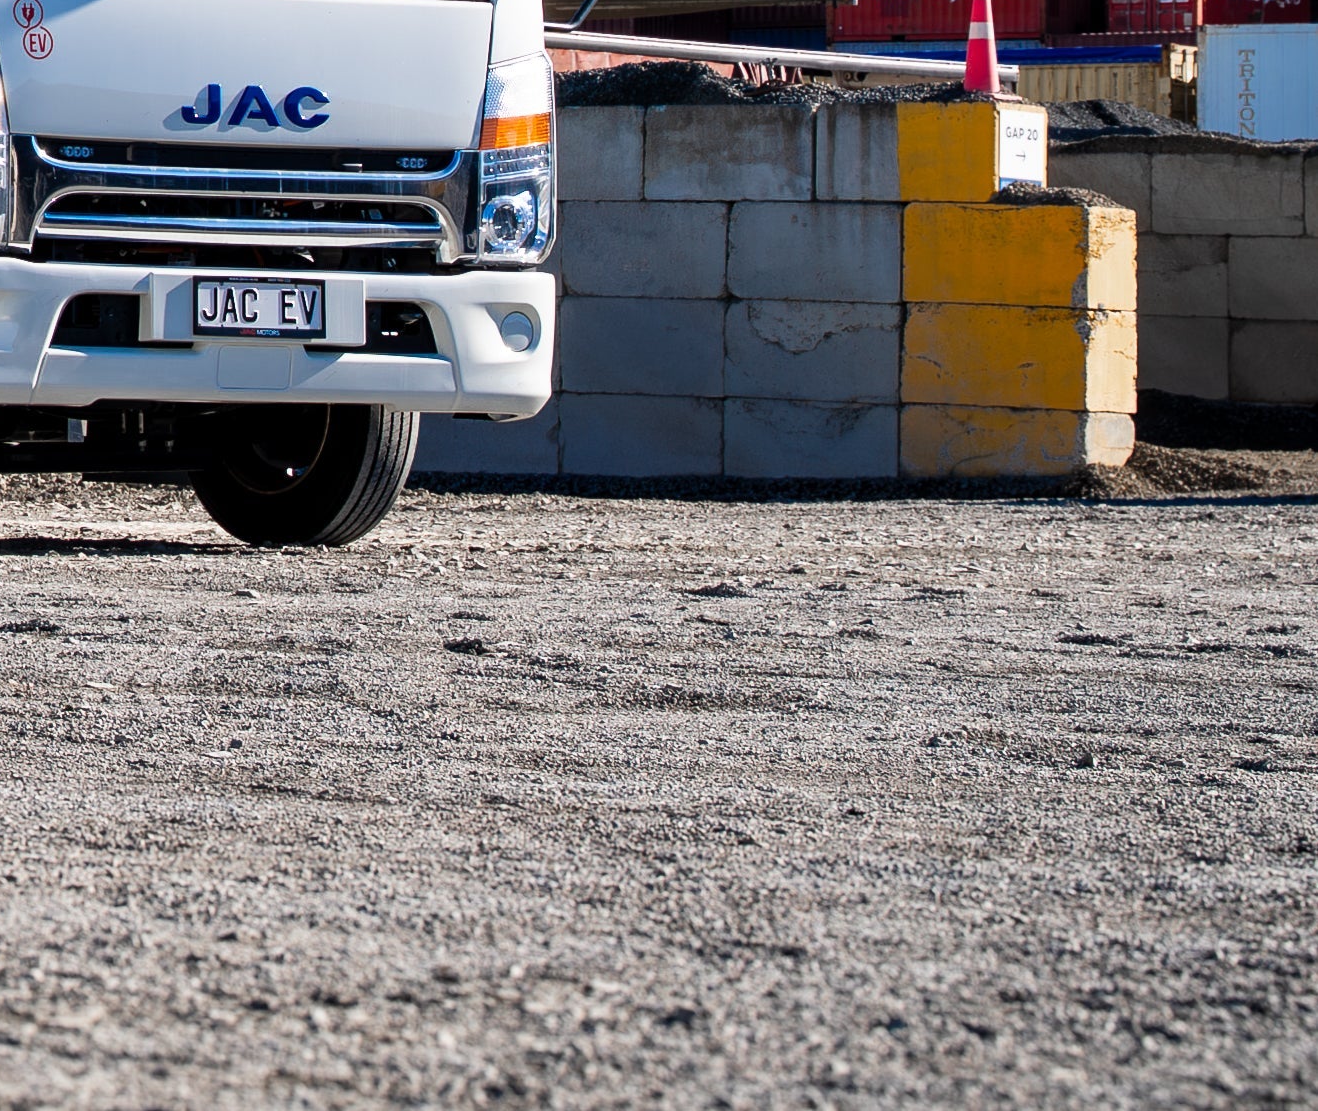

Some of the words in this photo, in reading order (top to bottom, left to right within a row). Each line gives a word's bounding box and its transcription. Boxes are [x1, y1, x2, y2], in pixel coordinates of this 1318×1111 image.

[29, 33, 47, 53] EV
[181, 83, 331, 129] JAC
[1238, 49, 1256, 137] TRITON
[1005, 126, 1024, 138] GAP
[1027, 128, 1038, 141] 20
[202, 287, 259, 323] JAC
[281, 290, 317, 325] EV
[239, 328, 256, 337] JAC
[257, 329, 281, 337] MOTORS
